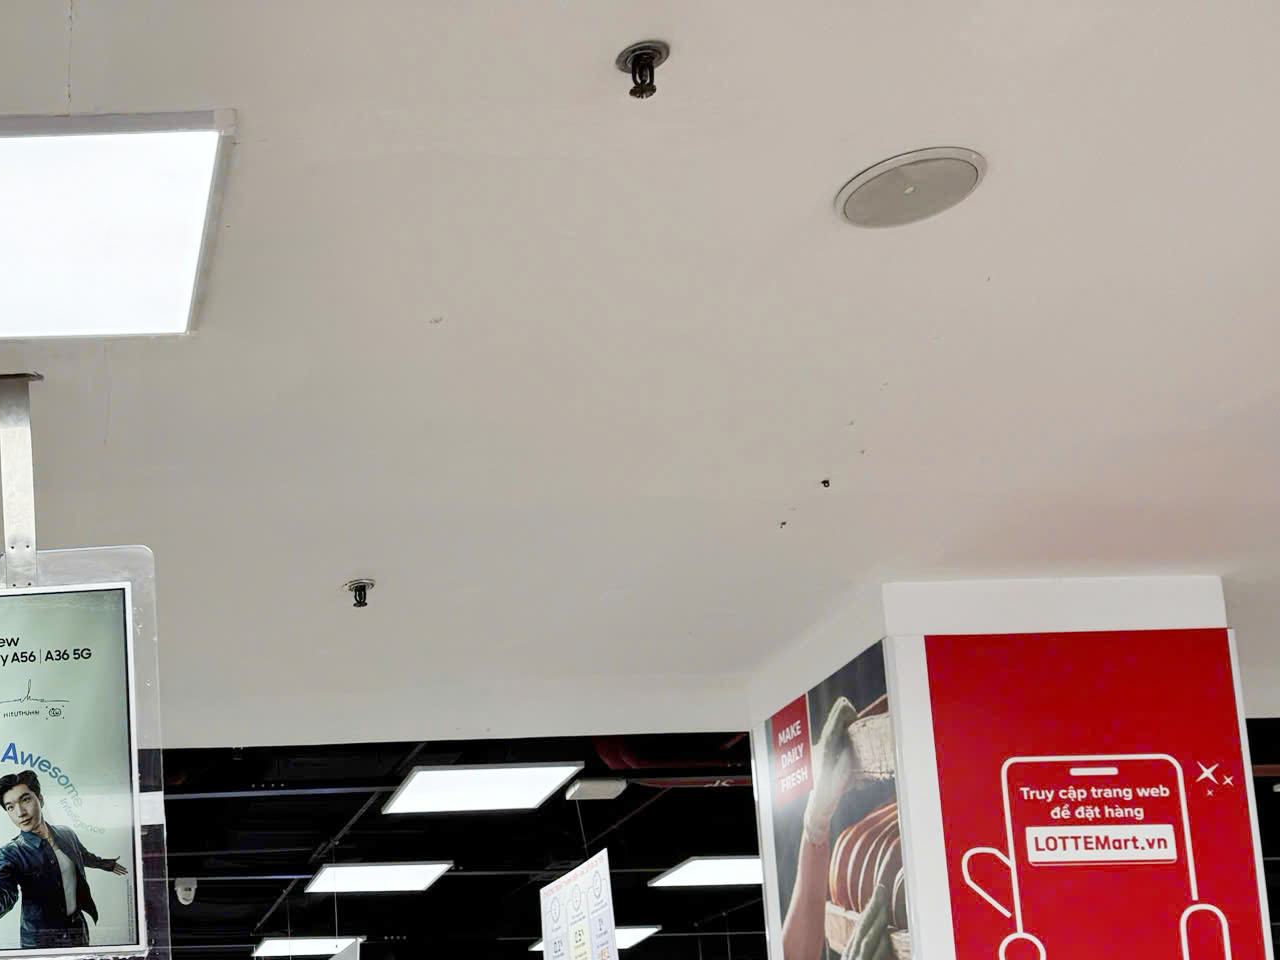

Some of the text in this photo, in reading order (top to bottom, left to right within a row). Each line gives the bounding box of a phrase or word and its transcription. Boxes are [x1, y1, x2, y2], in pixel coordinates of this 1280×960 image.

[11, 651, 36, 663] A56
[45, 649, 70, 661] A36
[73, 648, 92, 660] 5G
[778, 719, 802, 746] MAKE
[780, 743, 804, 770] DAILY
[0, 742, 83, 808] Awesome
[780, 767, 808, 793] FRESH
[1020, 784, 1170, 803] Truy cập trang web
[1050, 803, 1145, 821] để đặt hàng
[1034, 834, 1168, 853] LOTTEMart.vn
